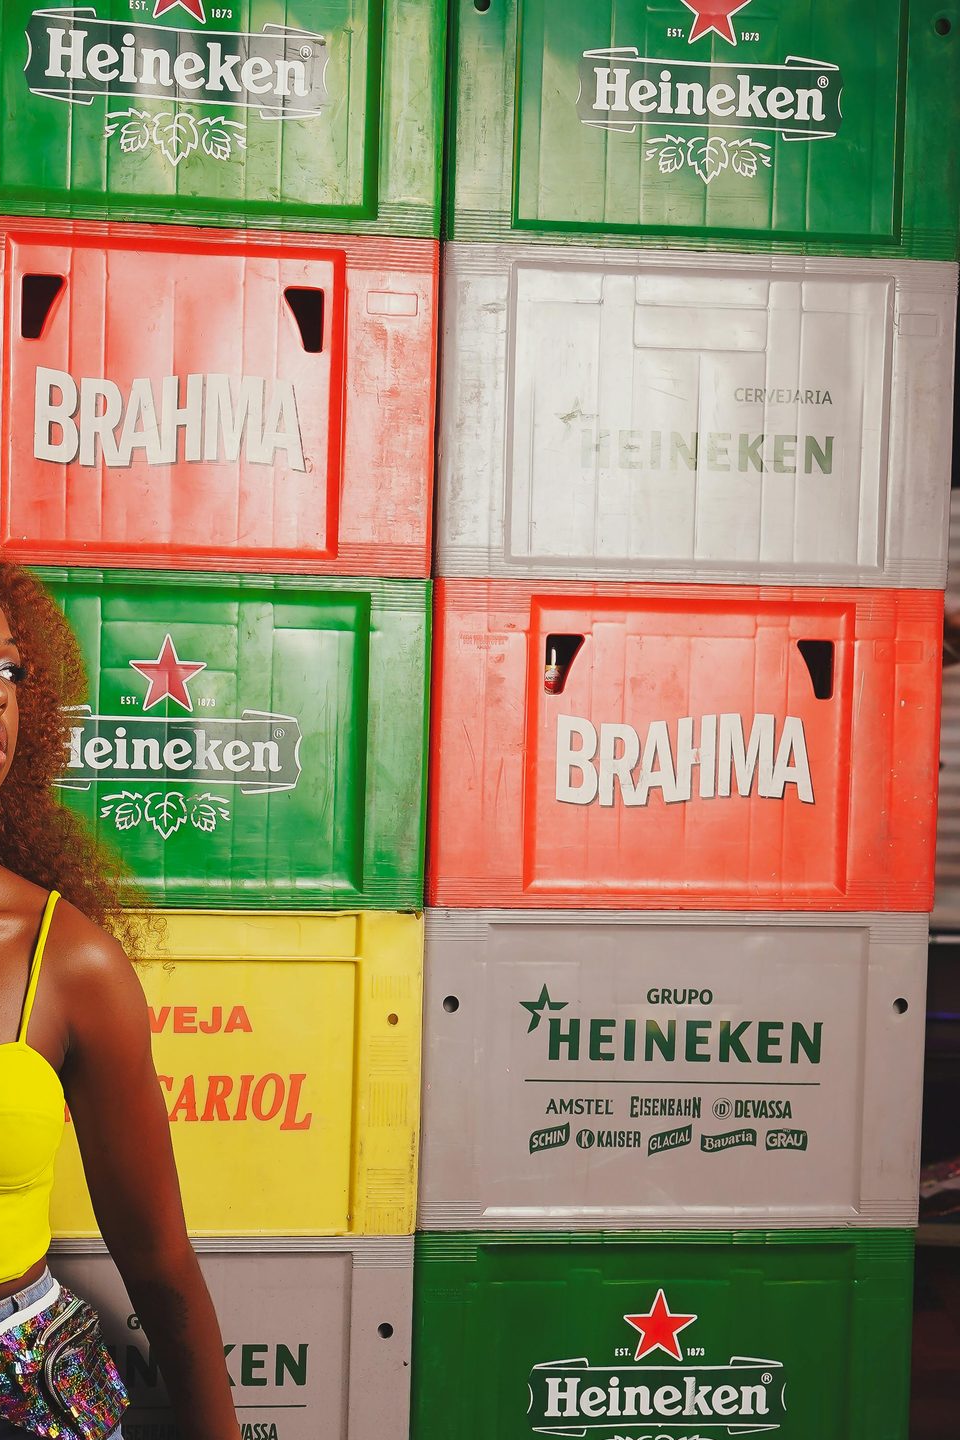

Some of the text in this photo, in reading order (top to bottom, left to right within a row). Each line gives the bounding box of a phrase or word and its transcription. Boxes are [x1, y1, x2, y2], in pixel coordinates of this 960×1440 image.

[211, 8, 233, 19] 1873
[667, 28, 760, 42] EST. 1873
[733, 387, 833, 405] CERVEJARIA
[33, 365, 307, 473] BRAHMA
[581, 428, 835, 475] HEINEKEN
[197, 697, 216, 707] 1873
[554, 713, 817, 808] BRAHMA
[646, 987, 714, 1006] GRUPO
[547, 1018, 824, 1065] HEINEKEN
[545, 1098, 613, 1116] AMSTEL
[630, 1096, 702, 1119] EISENBAHN
[734, 1100, 792, 1119] DEVASSA
[531, 1128, 567, 1149] SCHIN
[597, 1130, 641, 1148] KAISER
[649, 1129, 691, 1151] GLACIAL
[703, 1131, 753, 1151] Bavaria
[766, 1132, 803, 1148] GRAU
[614, 1347, 705, 1357] EST. 1873
